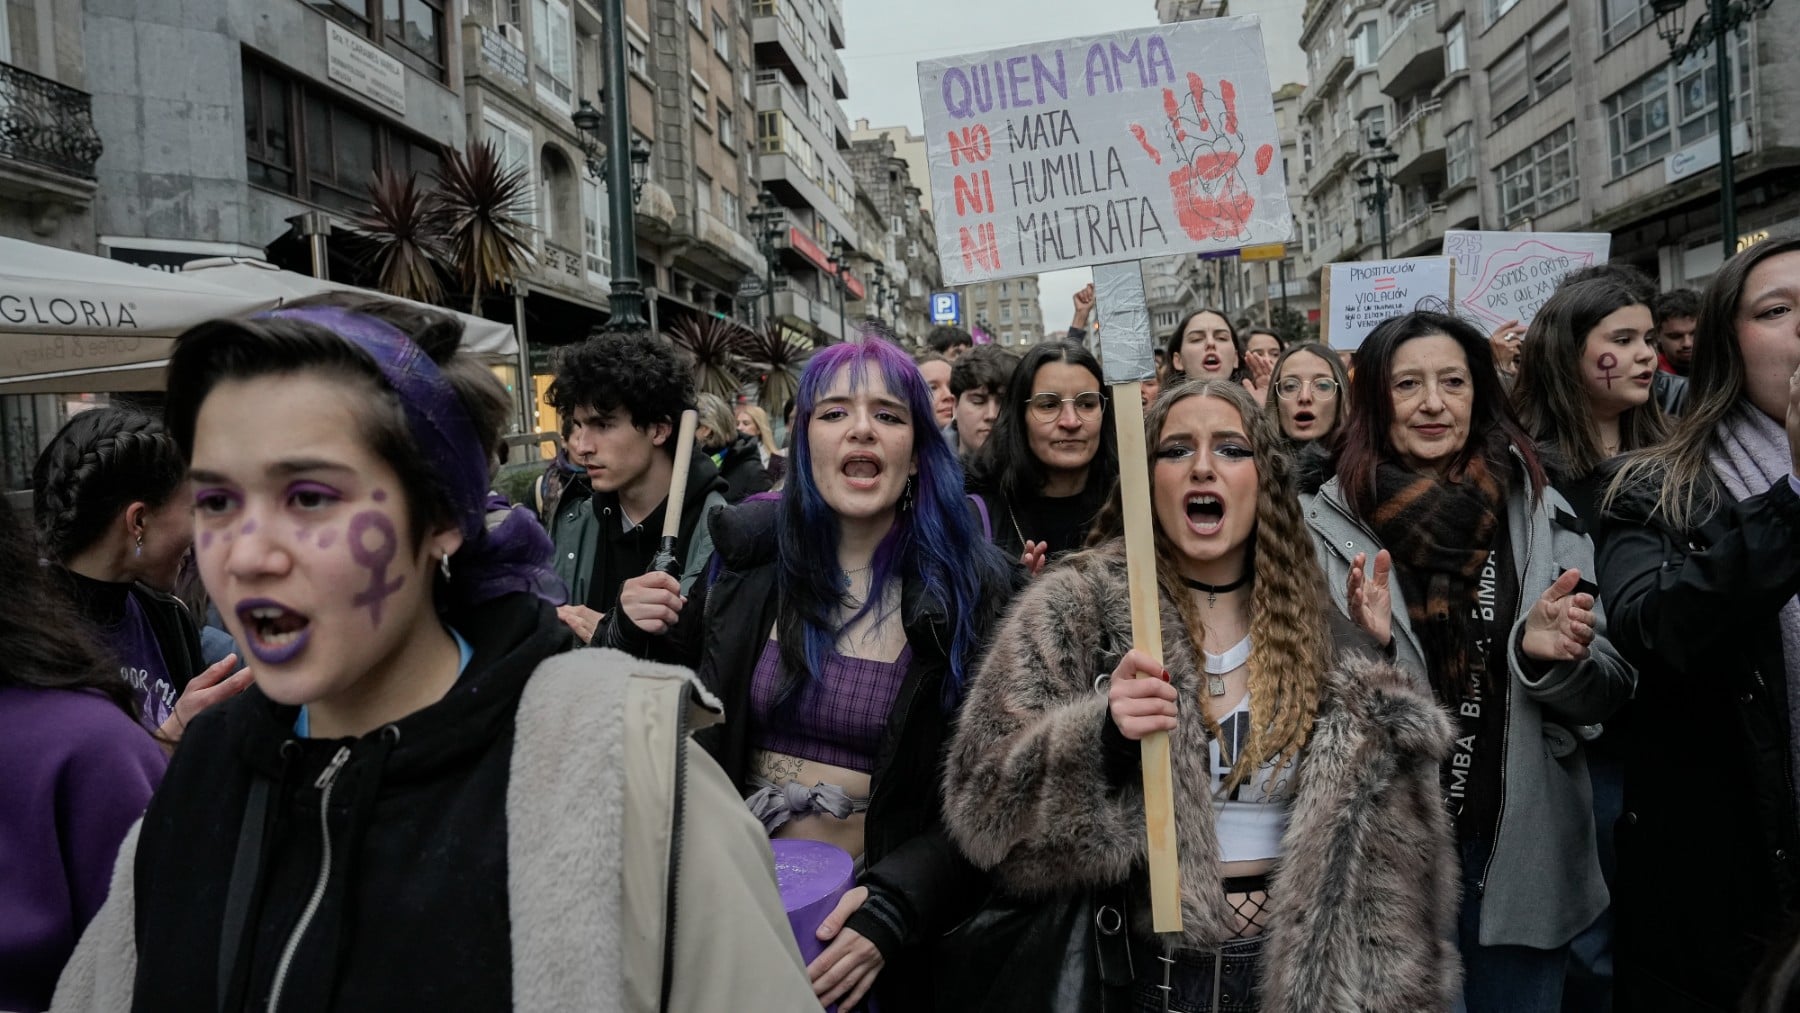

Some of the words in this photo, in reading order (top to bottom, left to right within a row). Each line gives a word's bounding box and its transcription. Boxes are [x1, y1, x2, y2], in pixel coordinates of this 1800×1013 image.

[941, 49, 1068, 119] QUIEN
[1085, 34, 1176, 97] AMA
[948, 123, 992, 166] NO
[1007, 109, 1080, 153] MATA
[953, 169, 995, 217] NI
[1008, 146, 1129, 206] HUMILLA
[959, 221, 1001, 273] NI
[1016, 196, 1168, 266] MALTRATA
[1447, 233, 1482, 255] 25
[1350, 263, 1415, 282] PROSTITUCIÓN
[1487, 292, 1508, 308] DAS
[1514, 287, 1534, 302] QUE
[1534, 281, 1551, 295] XA
[1490, 265, 1528, 291] SOMOS
[1531, 265, 1538, 277] O
[1539, 256, 1569, 276] GRITO
[1355, 288, 1408, 306] VIOLACIÓN
[1445, 735, 1476, 815] IMBA
